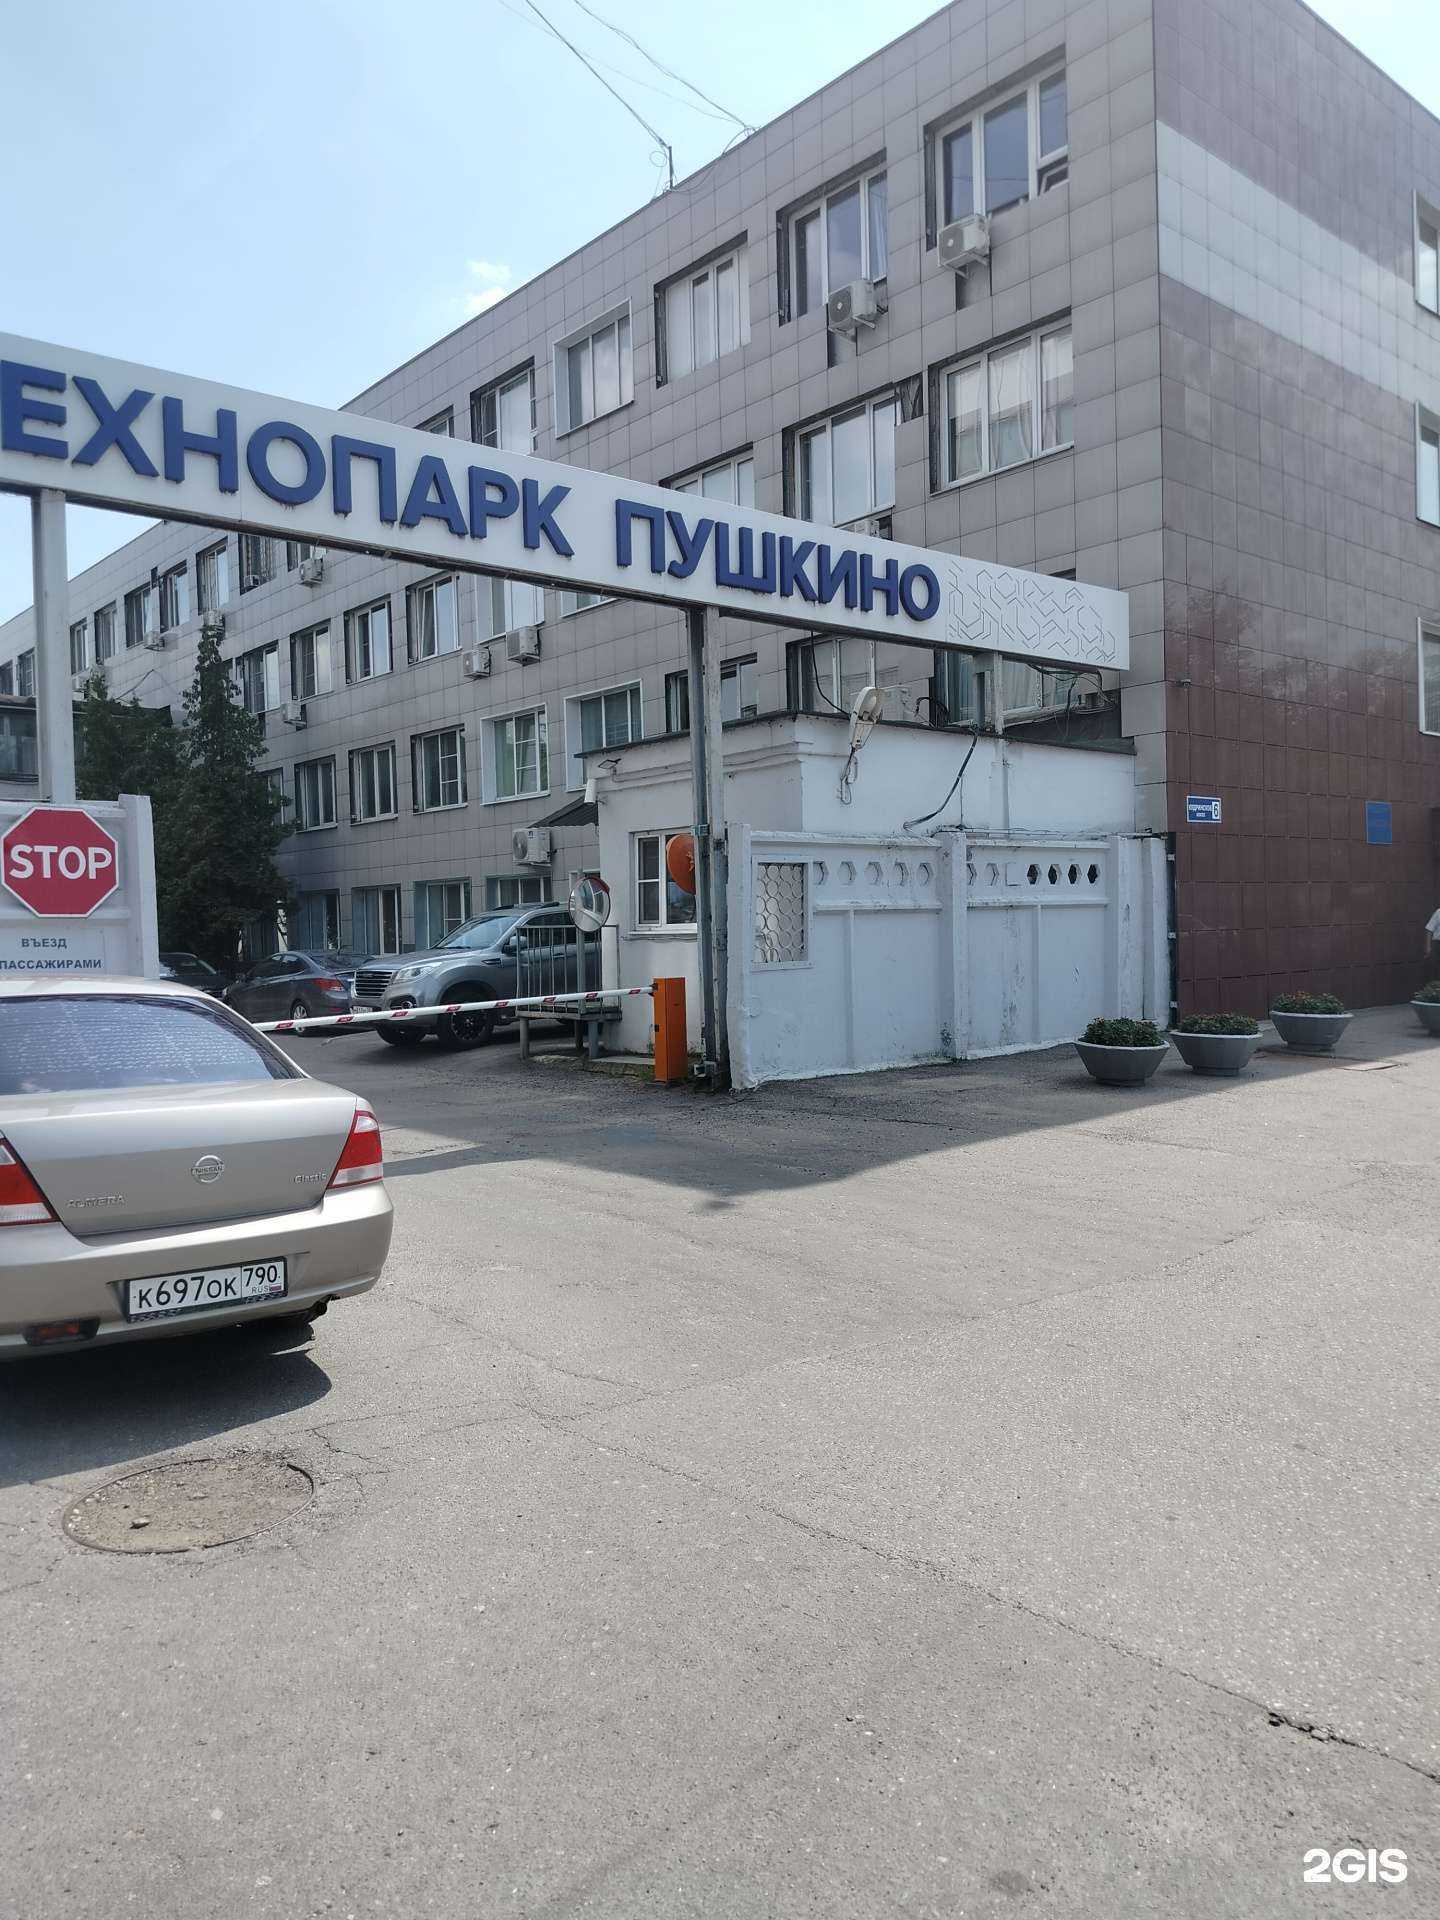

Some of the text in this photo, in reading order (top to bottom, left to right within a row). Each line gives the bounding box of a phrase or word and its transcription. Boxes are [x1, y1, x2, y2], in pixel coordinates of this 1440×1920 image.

[1, 359, 941, 622] ЕХНОПАРК ПУШКИНО
[1213, 804, 1219, 817] 6
[9, 844, 113, 880] STOP
[21, 937, 68, 950] ВЪЕЗД
[0, 959, 102, 970] ПАССАЖИРАМИ
[191, 1165, 225, 1175] NISSAN
[243, 1265, 278, 1287] 790
[251, 1286, 269, 1294] RUS
